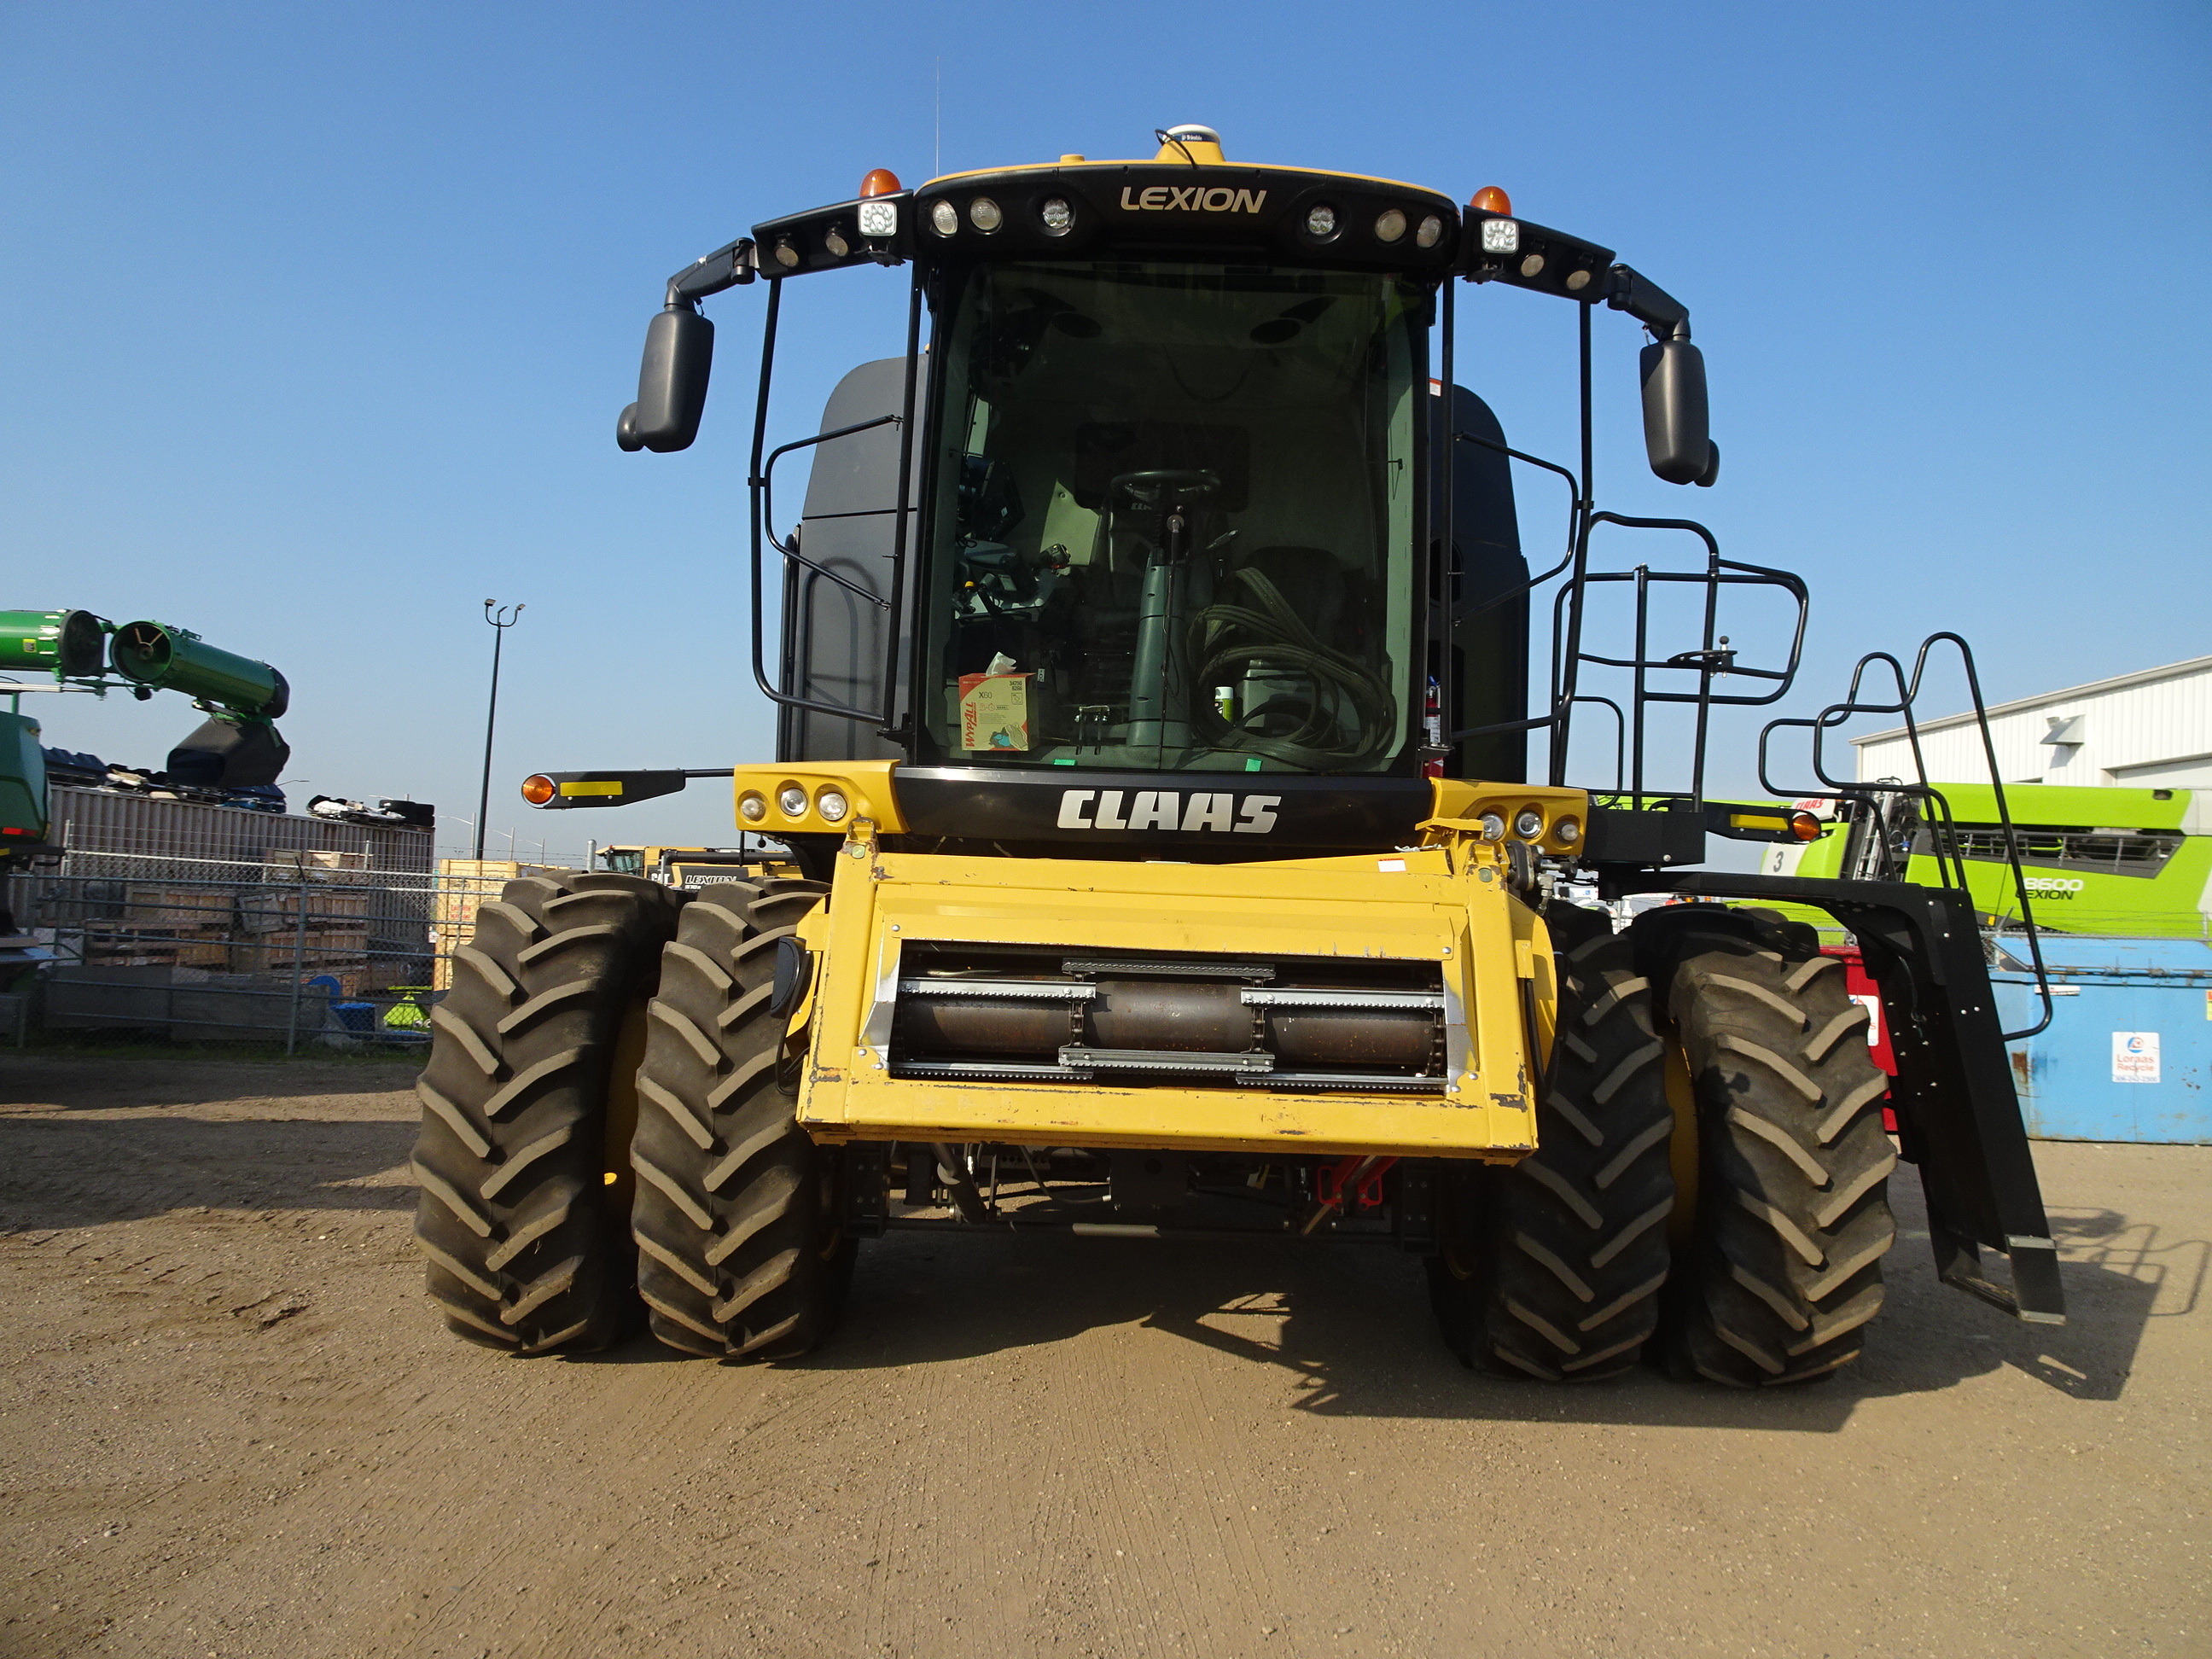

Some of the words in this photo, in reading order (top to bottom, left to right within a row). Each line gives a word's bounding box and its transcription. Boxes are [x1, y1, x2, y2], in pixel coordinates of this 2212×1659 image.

[1121, 186, 1267, 213] LEXION
[1057, 789, 1282, 834] CLAAS
[1773, 851, 1784, 872] 3
[2016, 889, 2075, 900] EXION
[2023, 877, 2084, 892] 8600
